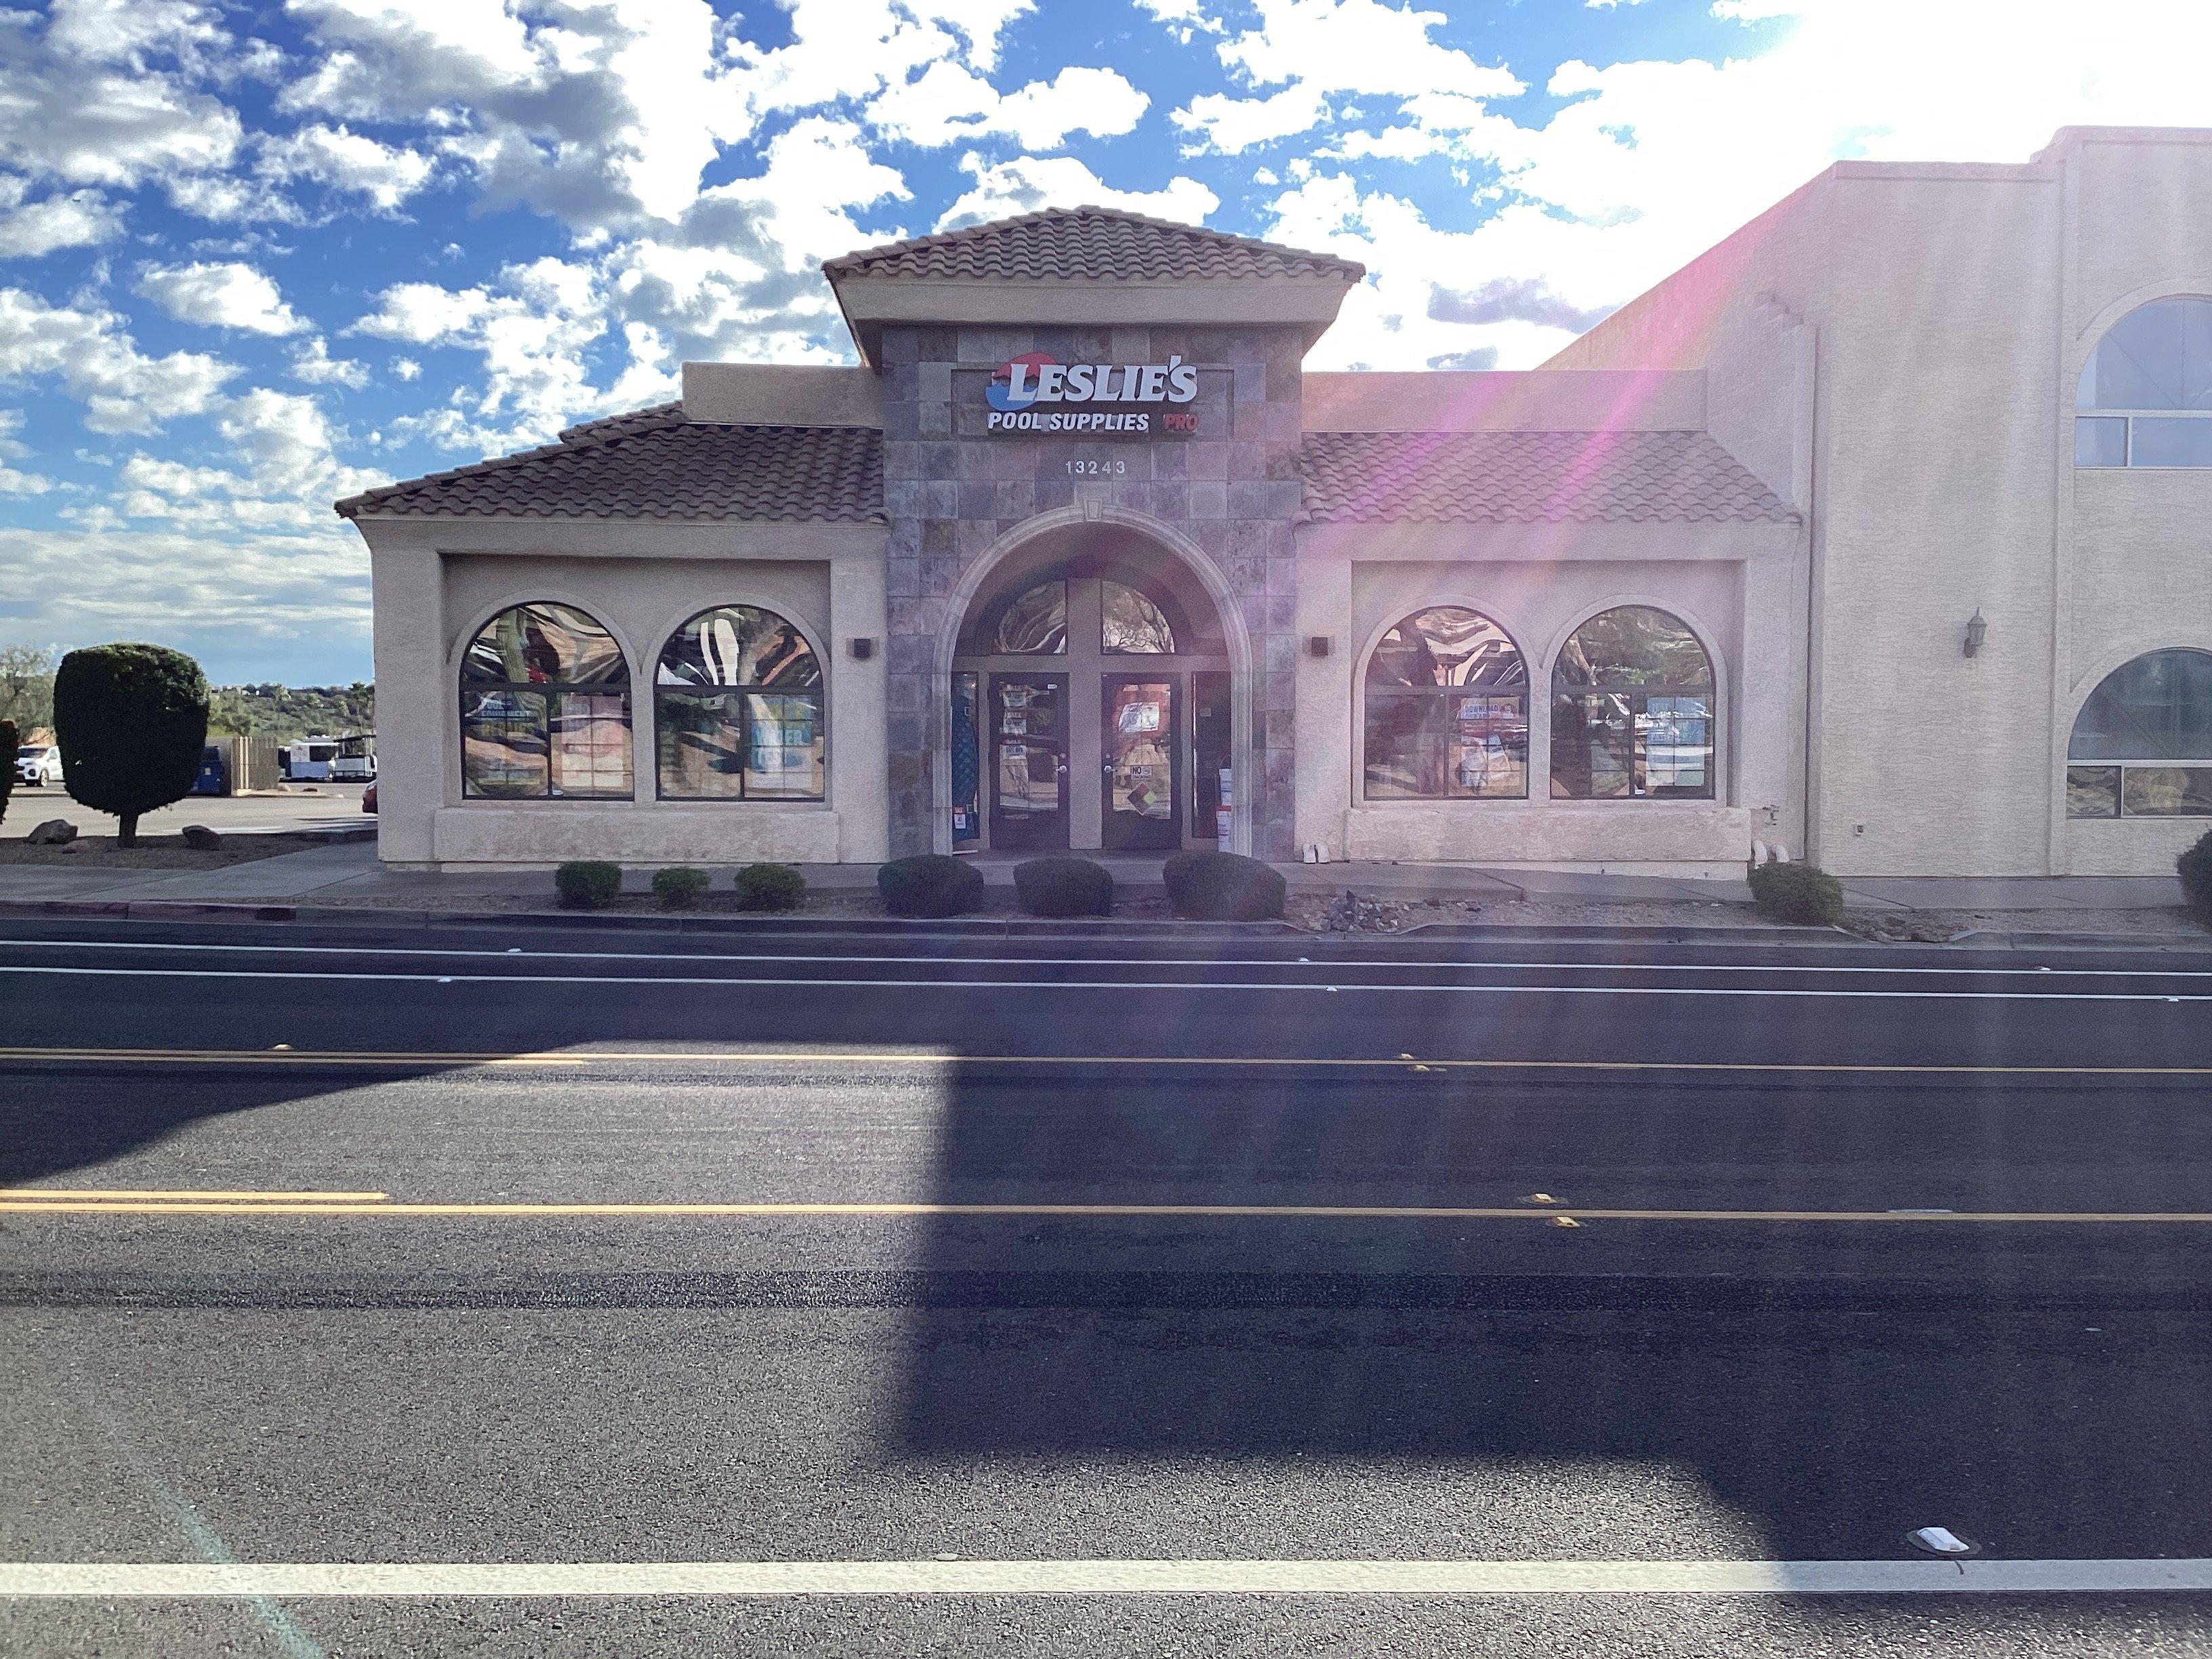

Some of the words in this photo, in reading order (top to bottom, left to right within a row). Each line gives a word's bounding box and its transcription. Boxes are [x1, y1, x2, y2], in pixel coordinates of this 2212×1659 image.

[1007, 354, 1198, 403] LESLIE'S
[987, 411, 1042, 430] POOL
[1049, 412, 1149, 431] SUPPLIES
[1163, 413, 1199, 431] PRO
[1065, 460, 1126, 474] 13243
[1132, 766, 1142, 775] NO
